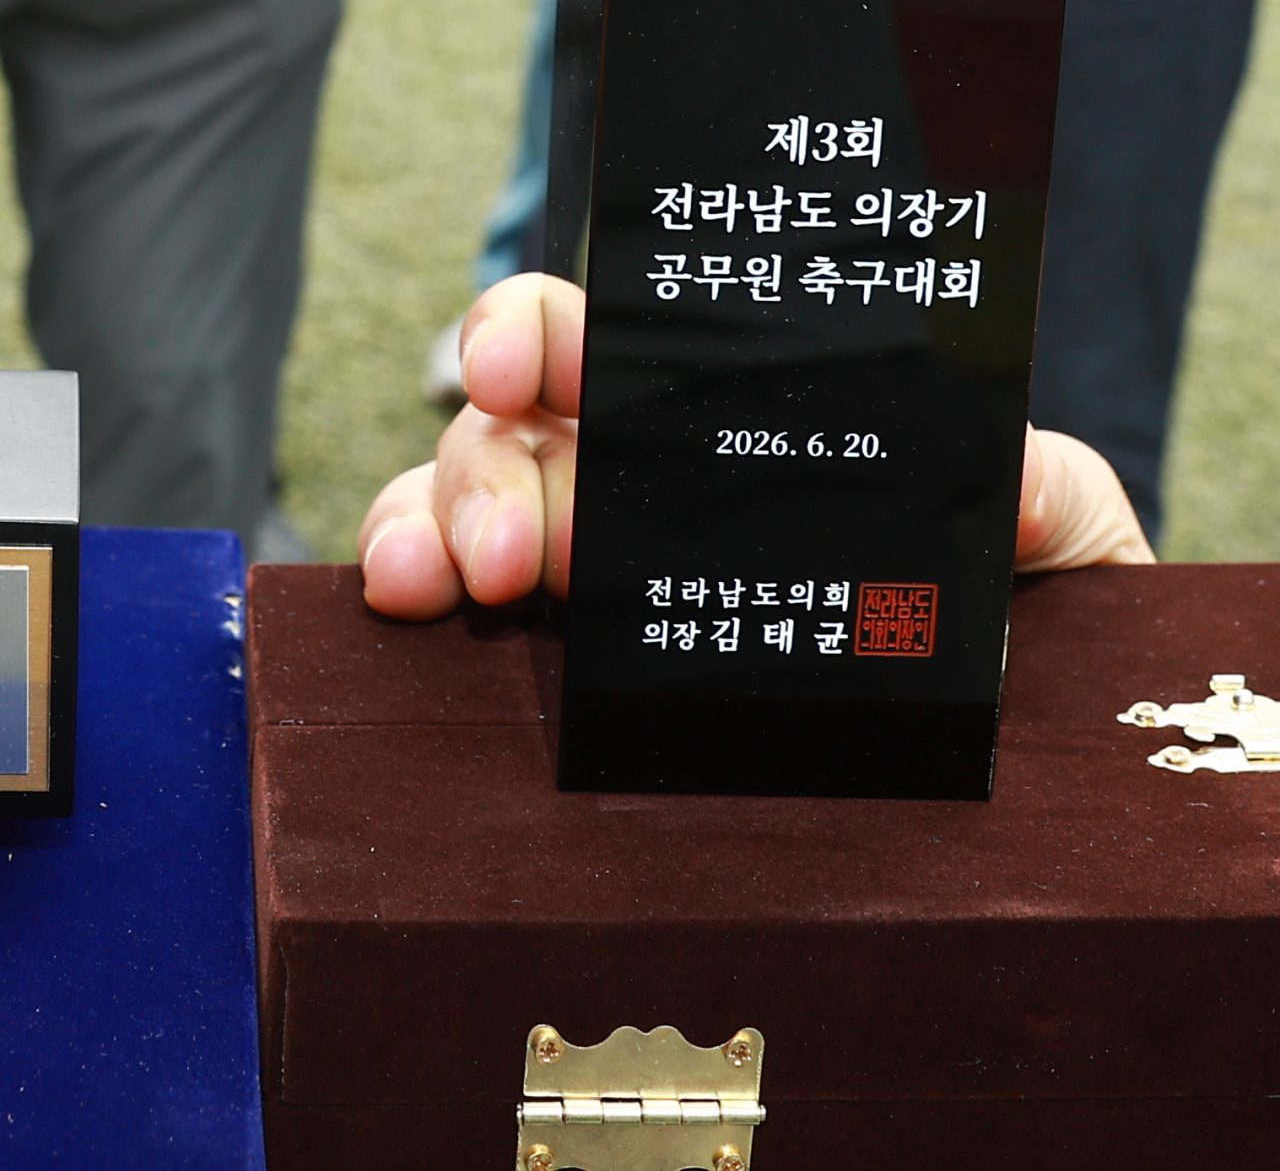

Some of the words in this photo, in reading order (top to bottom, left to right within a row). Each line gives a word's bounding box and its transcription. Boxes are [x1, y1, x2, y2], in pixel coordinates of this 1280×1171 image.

[764, 114, 884, 168] 제3회
[651, 182, 837, 234] 전라남도
[850, 187, 987, 240] 의장기
[646, 253, 783, 303] 공무원
[798, 255, 982, 308] 축구대회
[715, 429, 797, 456] 2026.
[806, 432, 833, 457] 6.
[842, 432, 887, 459] 20.
[642, 619, 702, 651] 의장
